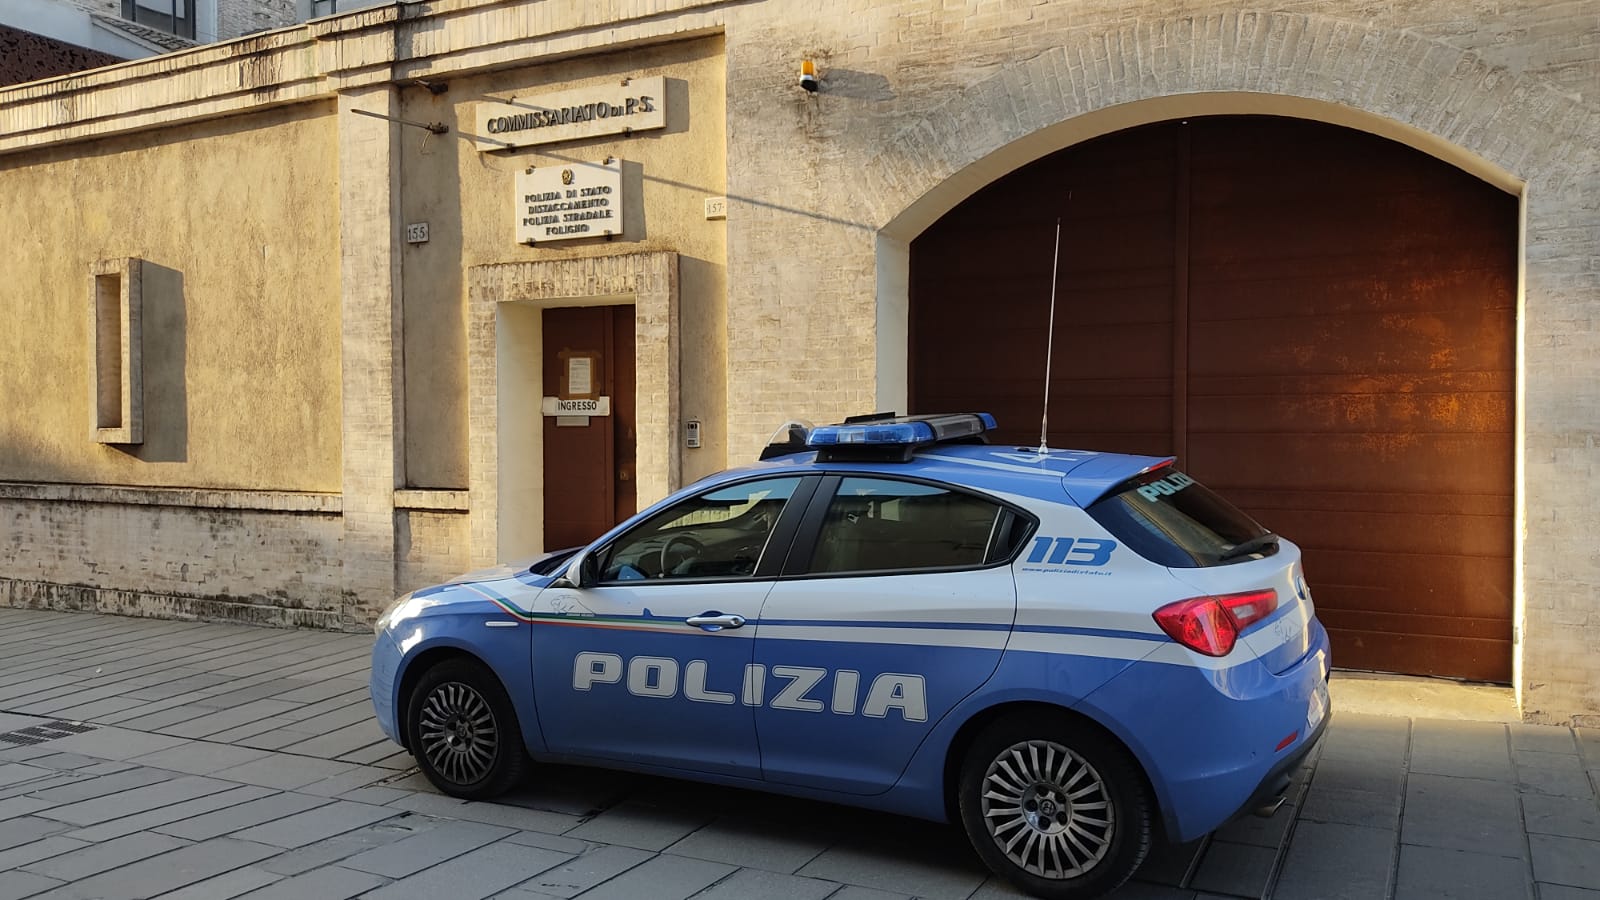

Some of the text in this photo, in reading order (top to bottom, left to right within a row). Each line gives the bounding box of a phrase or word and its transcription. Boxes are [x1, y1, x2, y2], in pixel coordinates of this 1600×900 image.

[487, 102, 608, 134] COMMISSARIATO
[525, 186, 612, 203] POLIZIA DI STATO
[528, 198, 609, 215] DISTACCAMENTO
[523, 209, 613, 226] POLIZIA STRADALE
[408, 226, 425, 240] 155
[546, 224, 589, 236] FOLIGNO
[558, 401, 597, 411] INGRESSO
[1026, 536, 1117, 566] 113
[572, 651, 928, 723] POLIZIA
